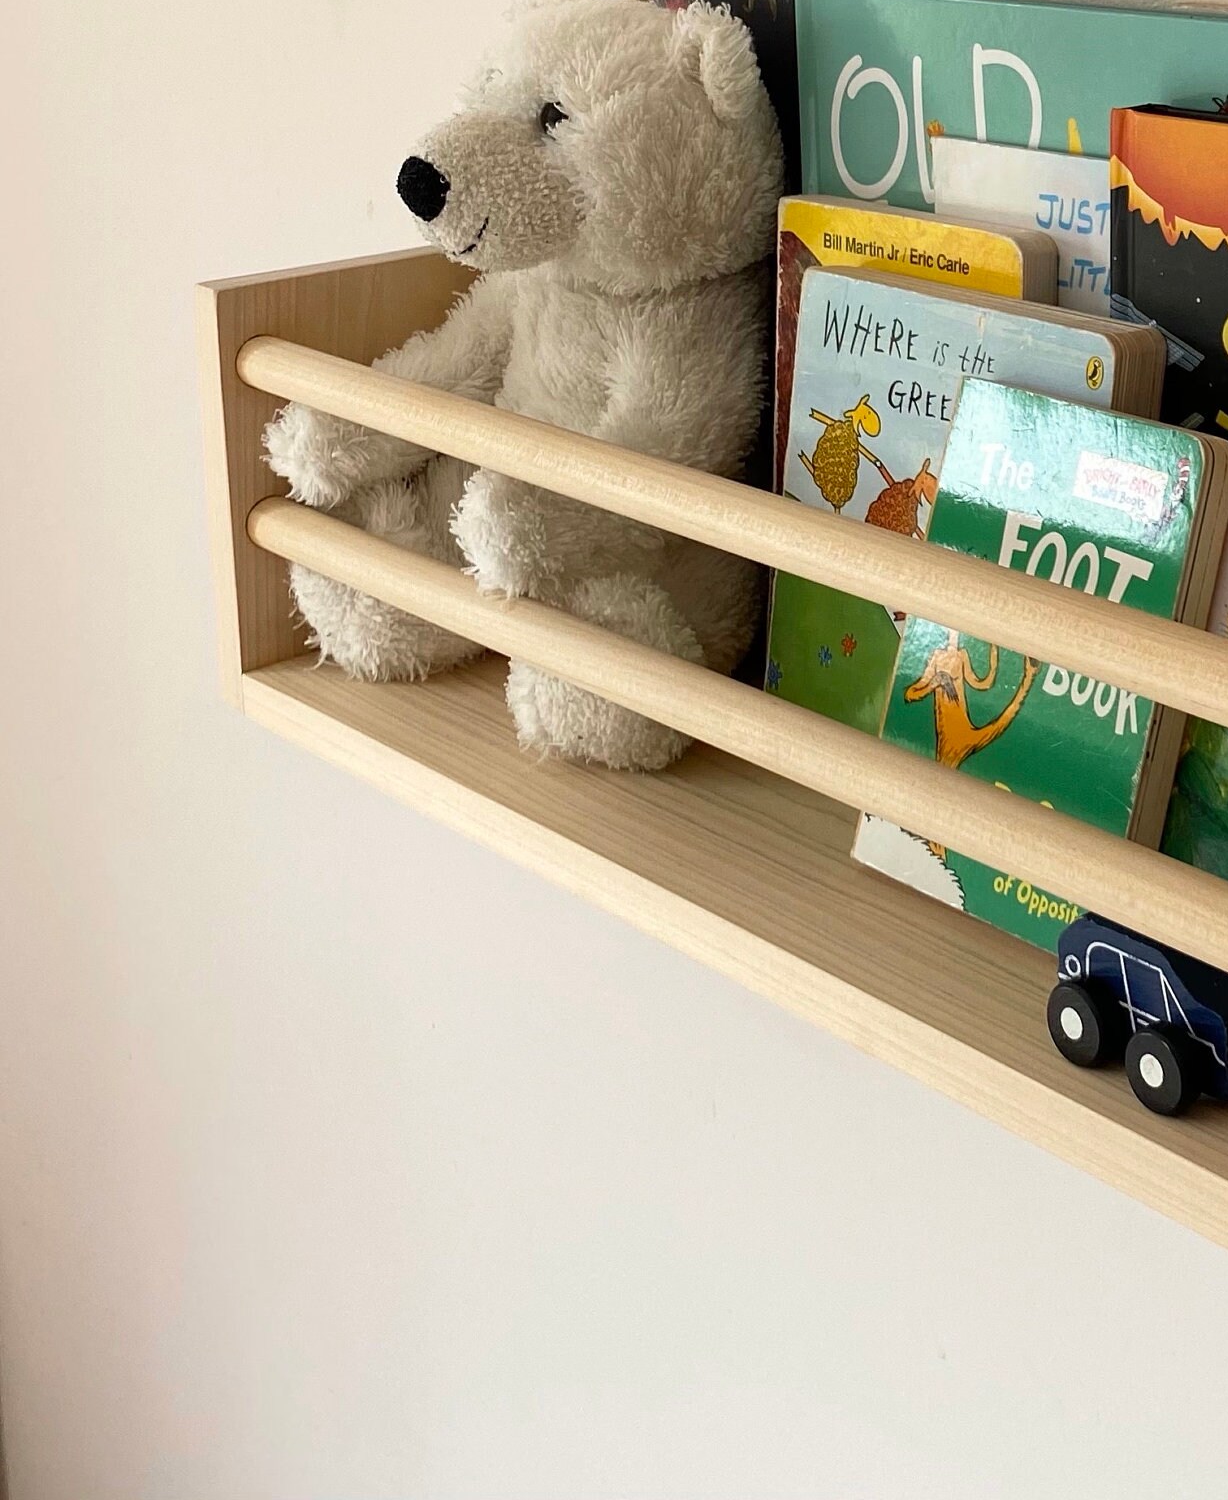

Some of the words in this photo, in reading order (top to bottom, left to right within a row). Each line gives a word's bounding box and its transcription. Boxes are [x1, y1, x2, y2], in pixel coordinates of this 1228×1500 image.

[1036, 194, 1110, 236] JUST
[823, 232, 842, 252] Bill
[845, 236, 884, 259] Martin
[887, 244, 900, 262] Jr
[910, 248, 934, 268] Eric
[937, 253, 970, 276] Carle
[824, 299, 919, 361] WHERE
[888, 380, 952, 422] GREE
[979, 443, 1035, 491] The
[998, 510, 1154, 604] FOOT
